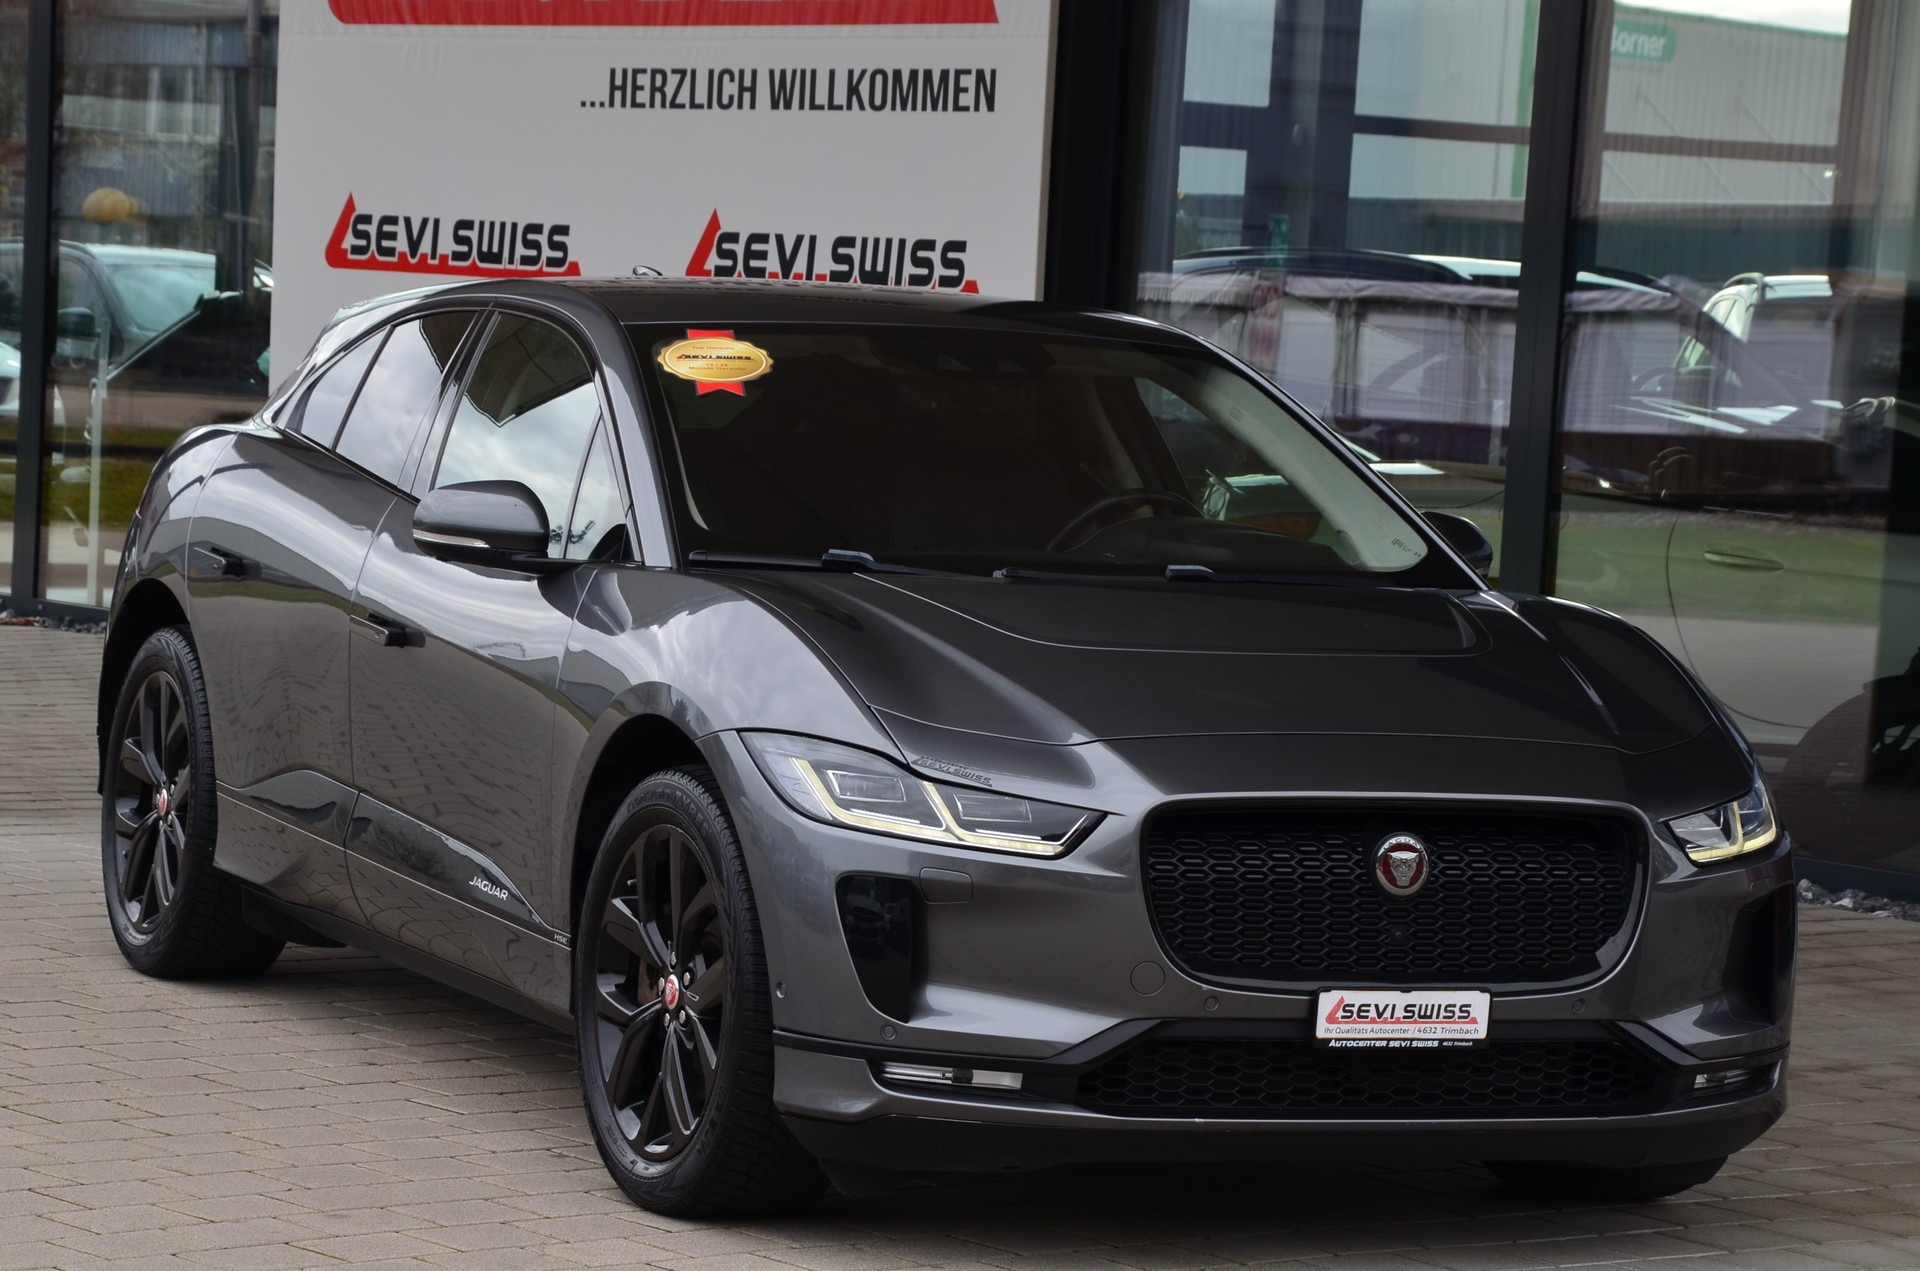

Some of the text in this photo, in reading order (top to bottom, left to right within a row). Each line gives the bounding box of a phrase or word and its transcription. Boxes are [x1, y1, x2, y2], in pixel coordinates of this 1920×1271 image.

[768, 68, 998, 113] WILLKOMMEN
[349, 213, 571, 269] SEVI SWISS
[713, 231, 968, 289] SEVI SWISS
[919, 760, 991, 785] SEVI SWISS
[469, 876, 509, 901] JAGUAR
[554, 933, 568, 945] HSE
[1340, 1003, 1472, 1020] SEVI SWISS
[1369, 1027, 1410, 1035] Autocenter
[1417, 1026, 1437, 1034] 4632
[1440, 1027, 1479, 1035] Trimbach
[1329, 1039, 1387, 1048] AUTOCENTER
[1388, 1040, 1410, 1048] SEVI
[1411, 1040, 1439, 1048] SWISS
